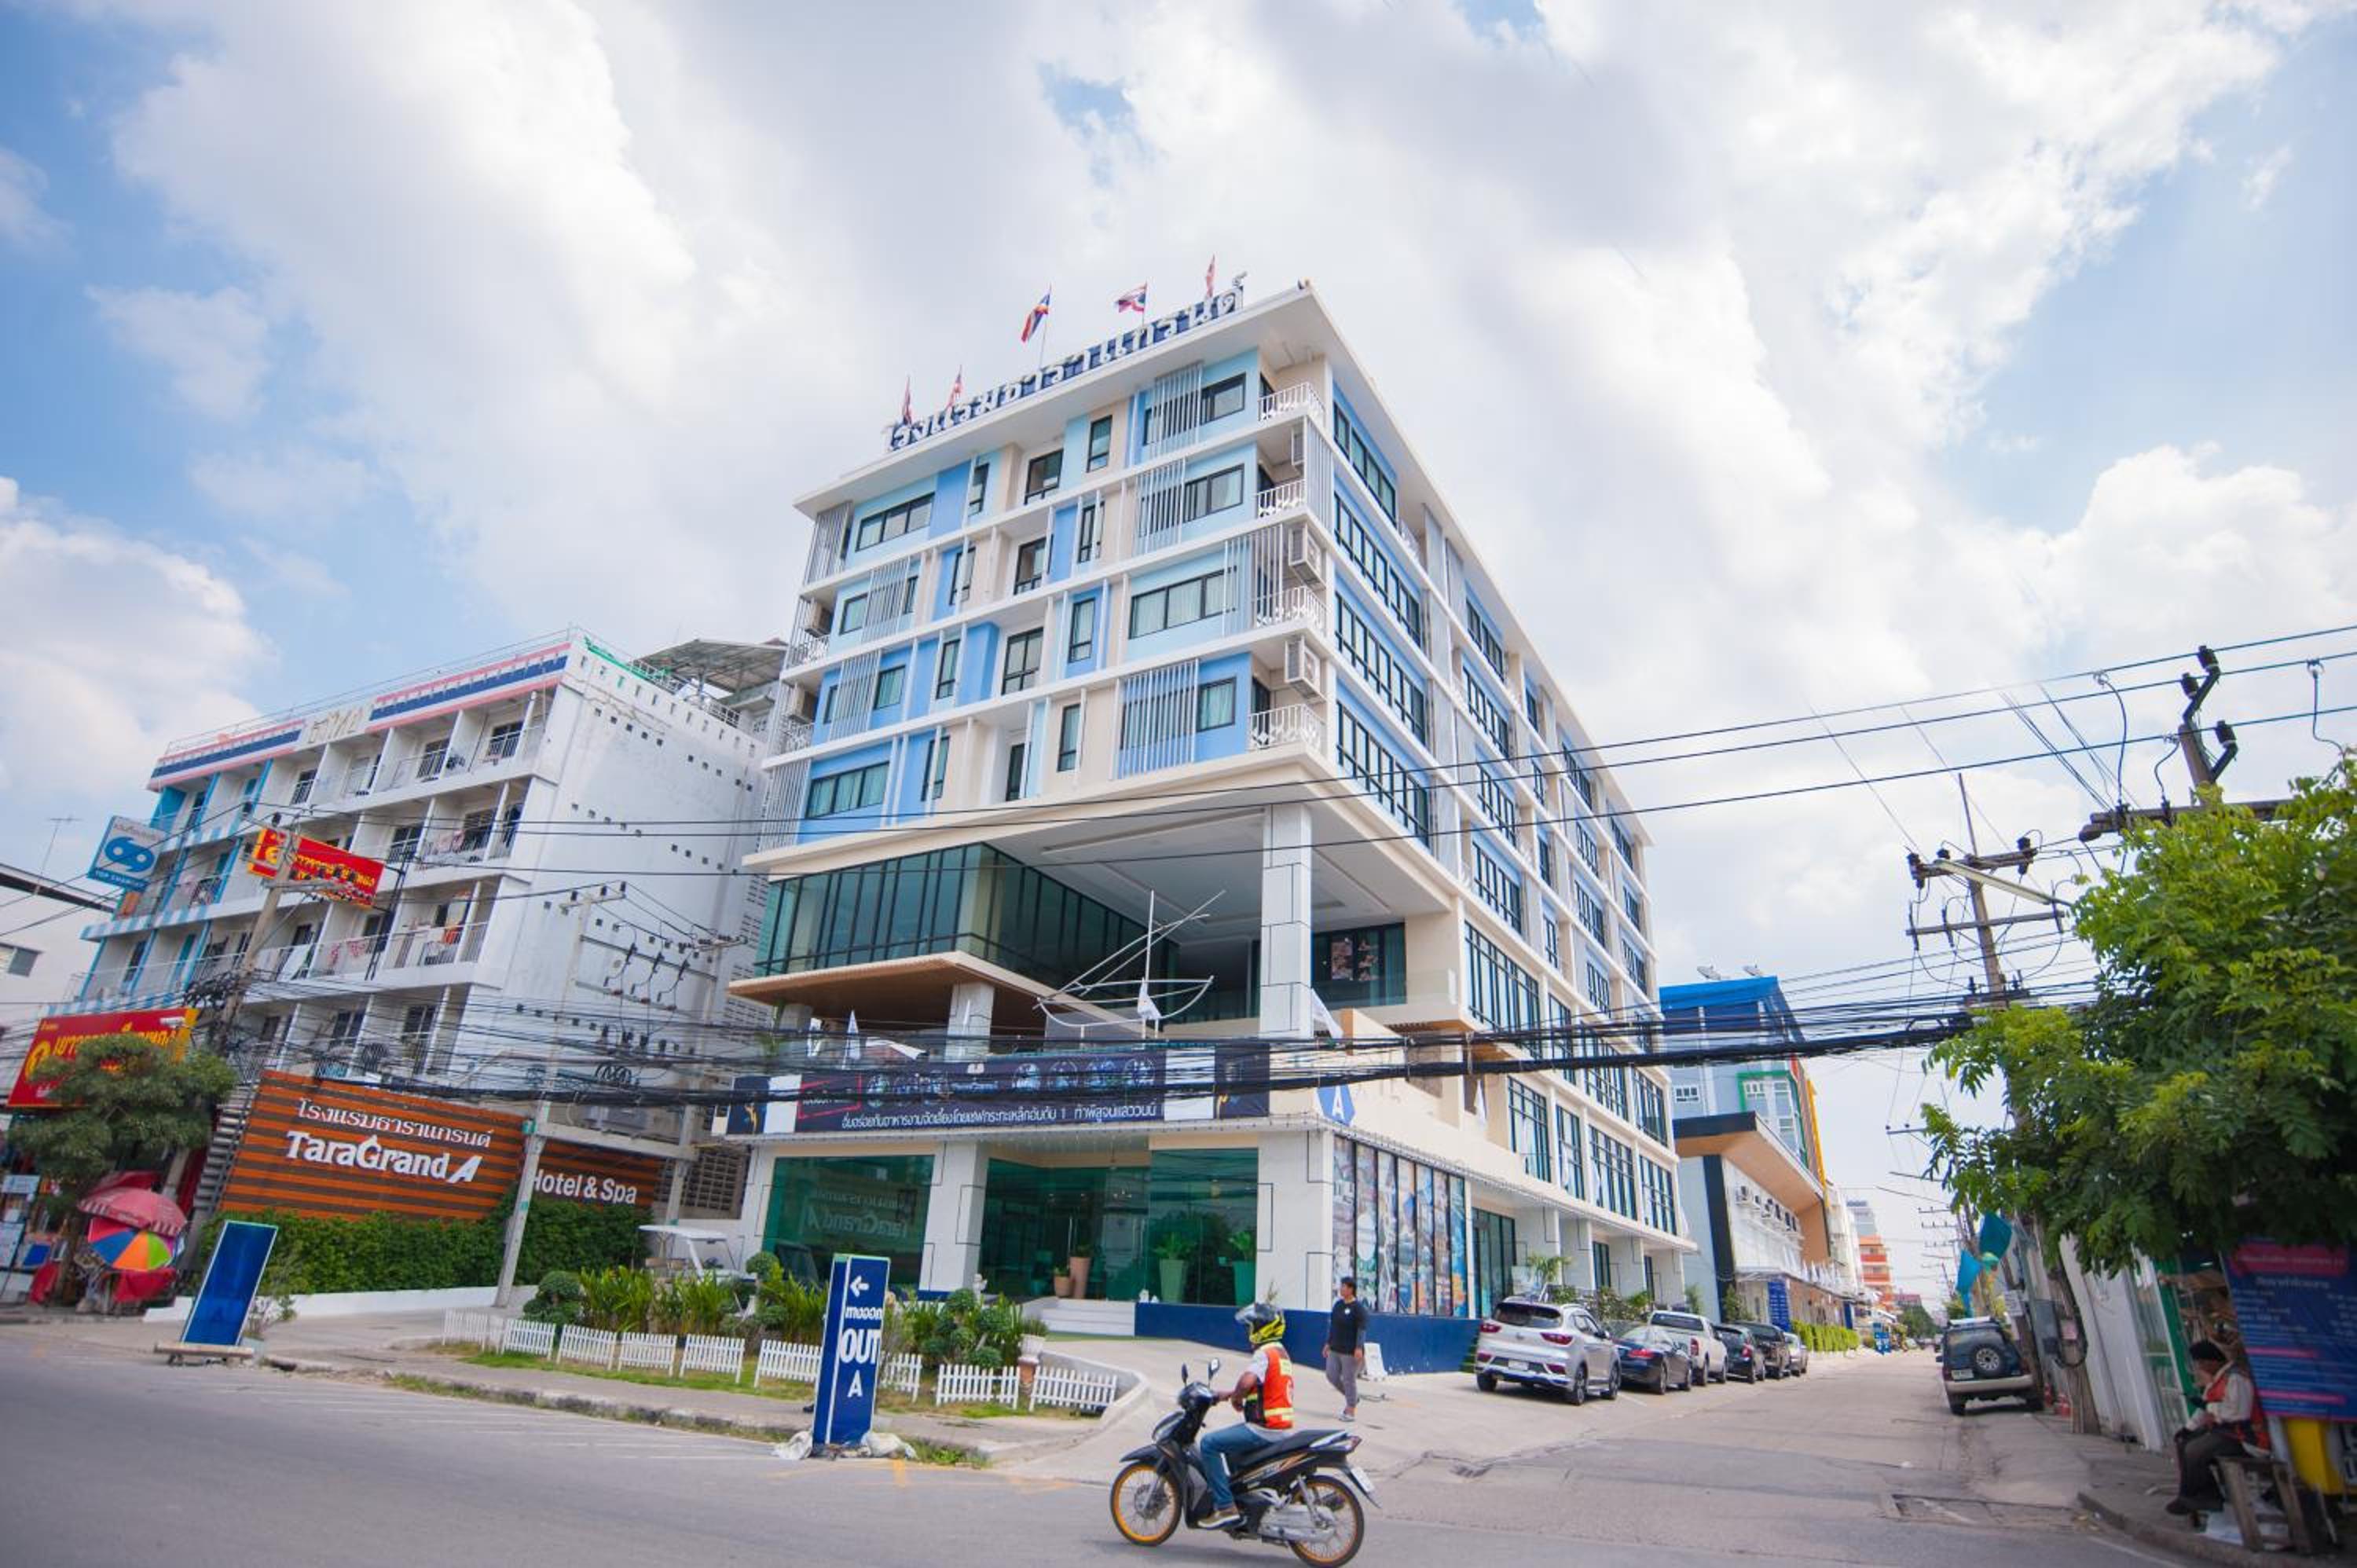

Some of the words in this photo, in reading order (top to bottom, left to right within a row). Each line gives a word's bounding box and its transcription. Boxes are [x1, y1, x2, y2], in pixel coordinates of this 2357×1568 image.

[297, 1097, 495, 1149] โรงแรมธาราแกรนด์
[285, 1130, 451, 1180] TaraGrand
[533, 1168, 583, 1197] Hotel
[583, 1176, 598, 1199] &
[600, 1178, 637, 1204] Spa
[845, 1306, 883, 1320] ทางออก
[840, 1328, 883, 1365] OUT
[847, 1369, 863, 1398] A
